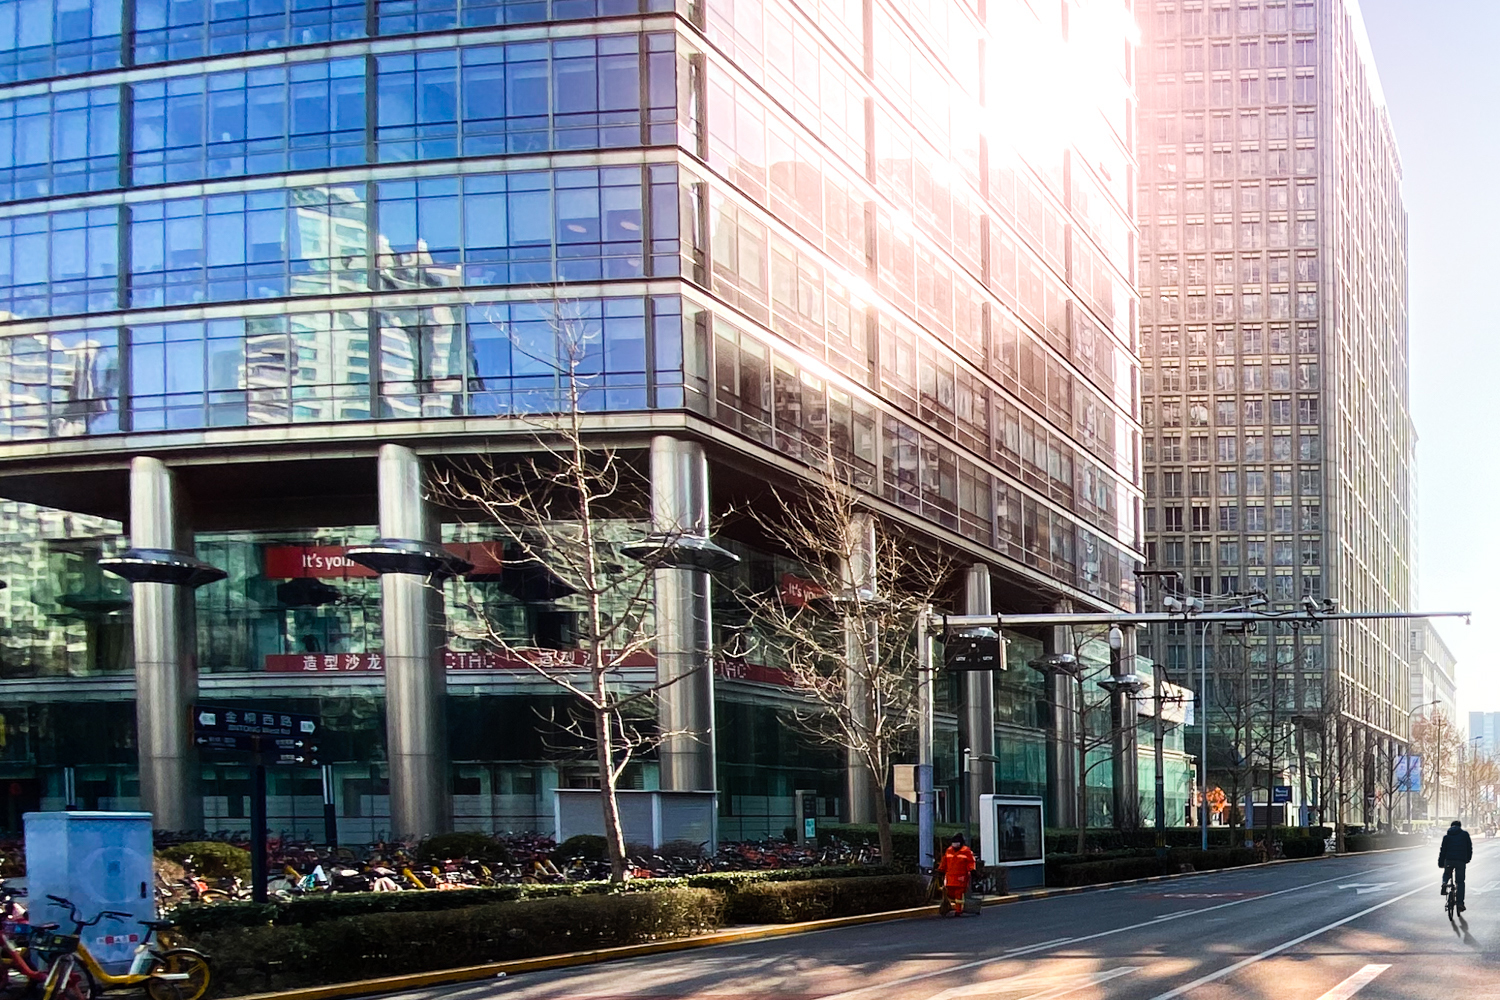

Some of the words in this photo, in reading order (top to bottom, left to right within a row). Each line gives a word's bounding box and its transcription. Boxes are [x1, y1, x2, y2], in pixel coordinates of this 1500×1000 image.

[302, 554, 323, 568] It's
[302, 655, 382, 671] 造型沙龙
[225, 711, 293, 727] 金桐西路
